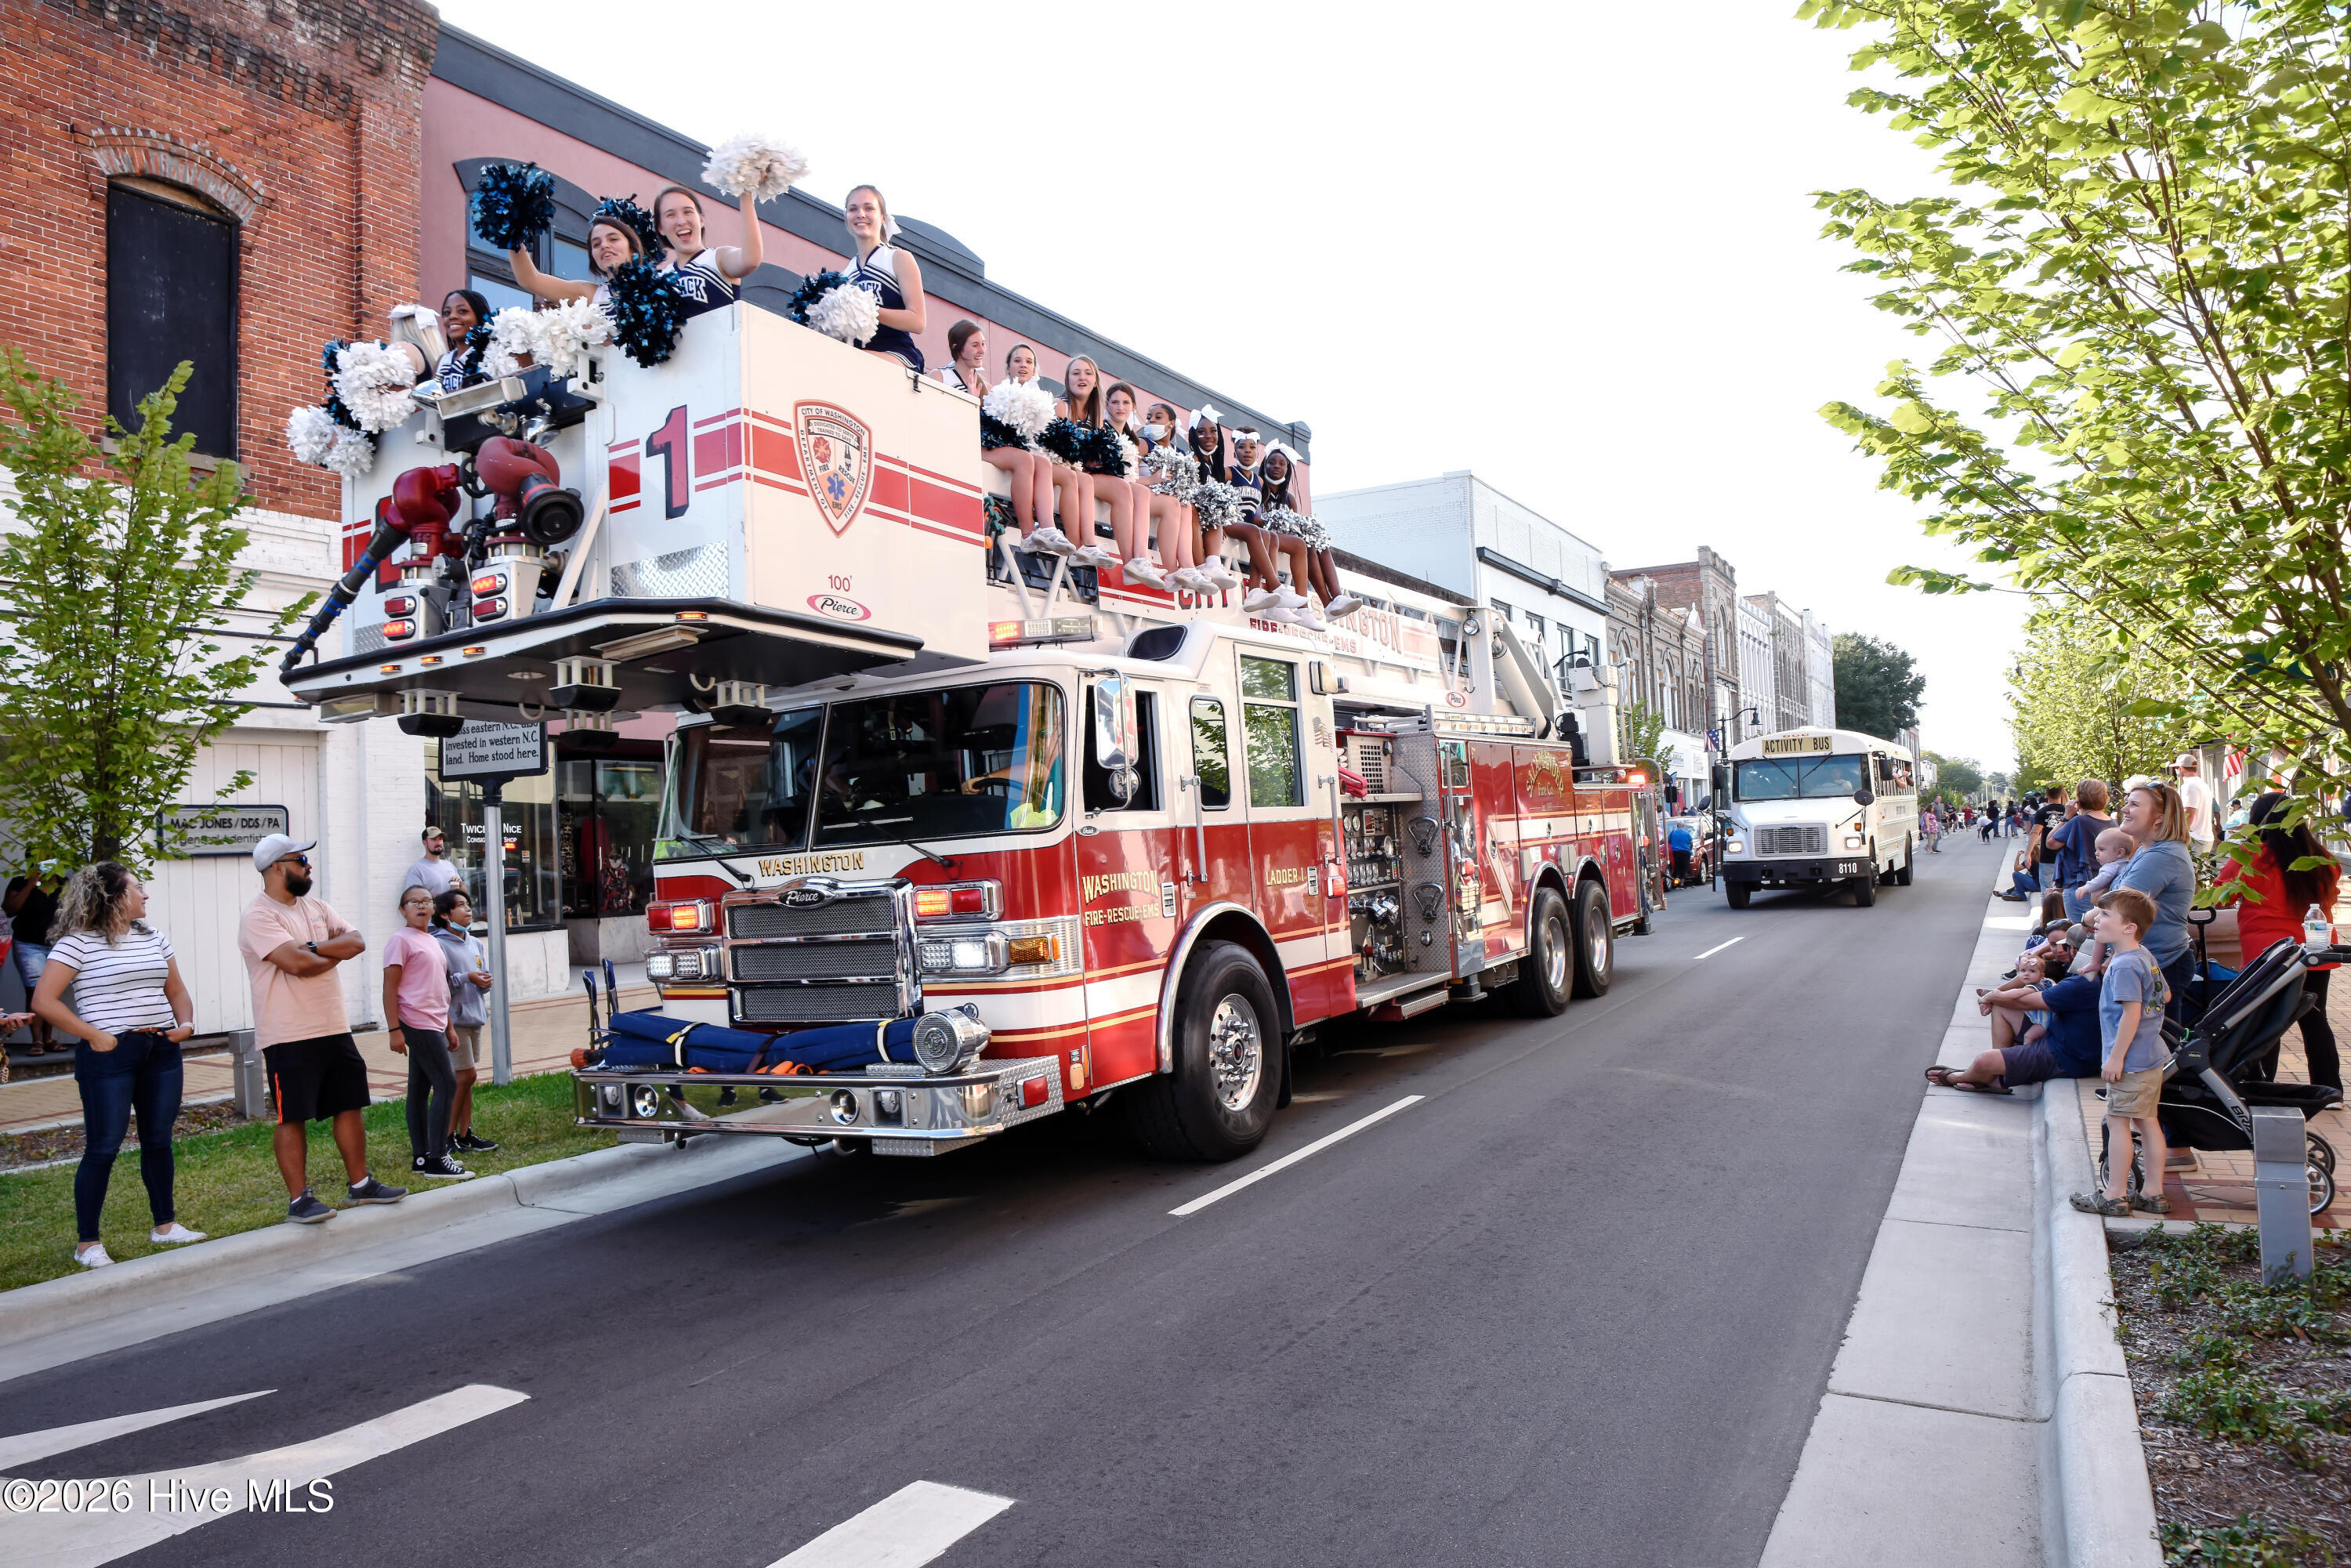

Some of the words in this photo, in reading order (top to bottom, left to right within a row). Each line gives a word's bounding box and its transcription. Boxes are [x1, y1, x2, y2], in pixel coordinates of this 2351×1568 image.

[824, 408, 866, 436] WASHINGTON
[647, 404, 689, 520] 1
[800, 429, 822, 494] DEPARTMENT
[820, 498, 828, 511] OF
[818, 463, 830, 473] FIRE
[838, 465, 856, 485] RESCUE
[831, 501, 842, 510] EMS
[820, 597, 858, 615] Pierce
[471, 723, 501, 733] eastern
[445, 739, 477, 751] invested
[480, 737, 487, 748] in
[489, 736, 520, 747] western
[523, 730, 538, 743] N.C.
[1765, 738, 1802, 753] ACTIVITY
[1813, 737, 1830, 750] BUS
[446, 753, 464, 765] land.
[469, 752, 490, 763] Home
[491, 748, 514, 761] stood
[517, 747, 539, 759] here.
[170, 818, 197, 829] MAC
[200, 817, 233, 829] JONES
[241, 817, 260, 829] DDS
[268, 817, 280, 828] PA
[503, 823, 522, 833] NICE
[759, 852, 864, 877] WASHINGTON
[1838, 862, 1857, 874] 8110
[1266, 868, 1299, 886] LADDER
[1082, 870, 1159, 905] WASHINGTON
[786, 889, 819, 905] Pierce
[1084, 903, 1160, 927] FIRE-RESCUE-EMS
